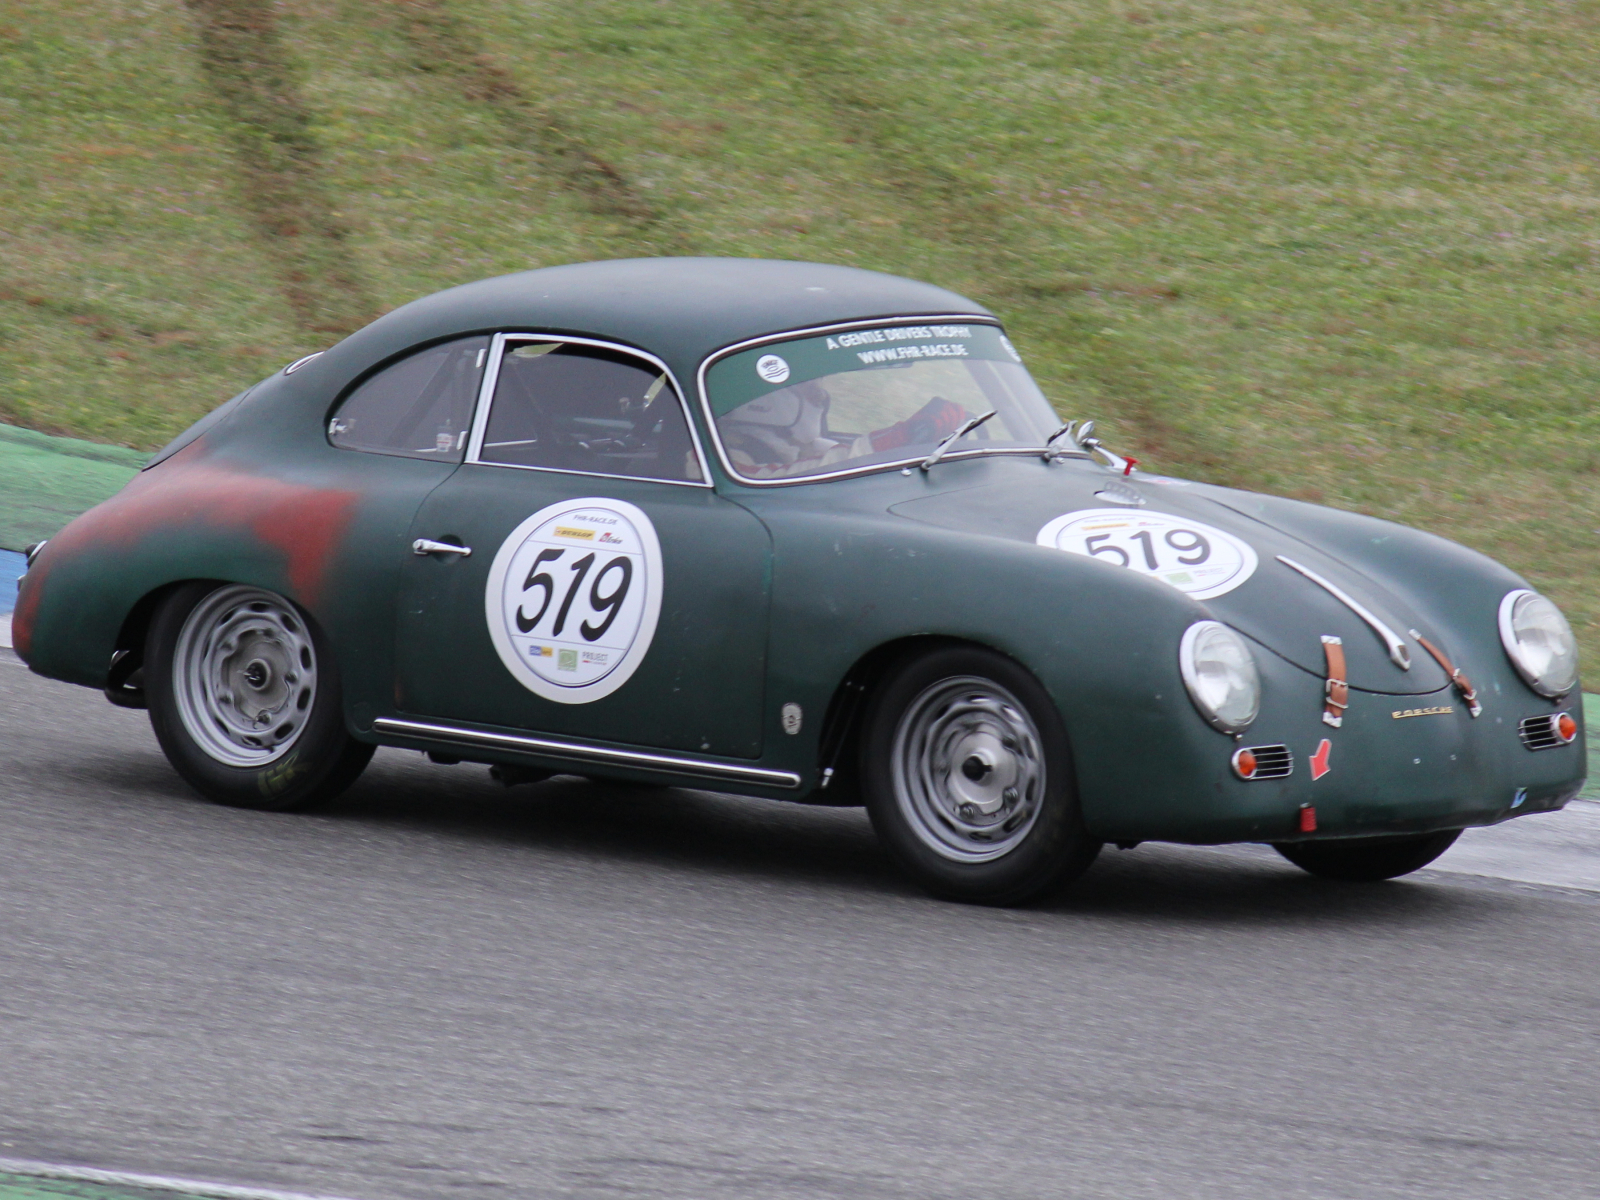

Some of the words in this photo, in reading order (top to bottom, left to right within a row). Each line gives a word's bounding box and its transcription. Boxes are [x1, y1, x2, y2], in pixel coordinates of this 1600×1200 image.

[826, 338, 840, 350] A
[838, 331, 885, 347] GENTLE
[884, 327, 931, 340] DRIVERS
[930, 326, 971, 338] TROPHY
[857, 345, 968, 363] WWW.FHR-RACE.DE
[1086, 529, 1210, 569] 519
[516, 549, 632, 641] 519
[1391, 706, 1454, 719] PORSCHE
